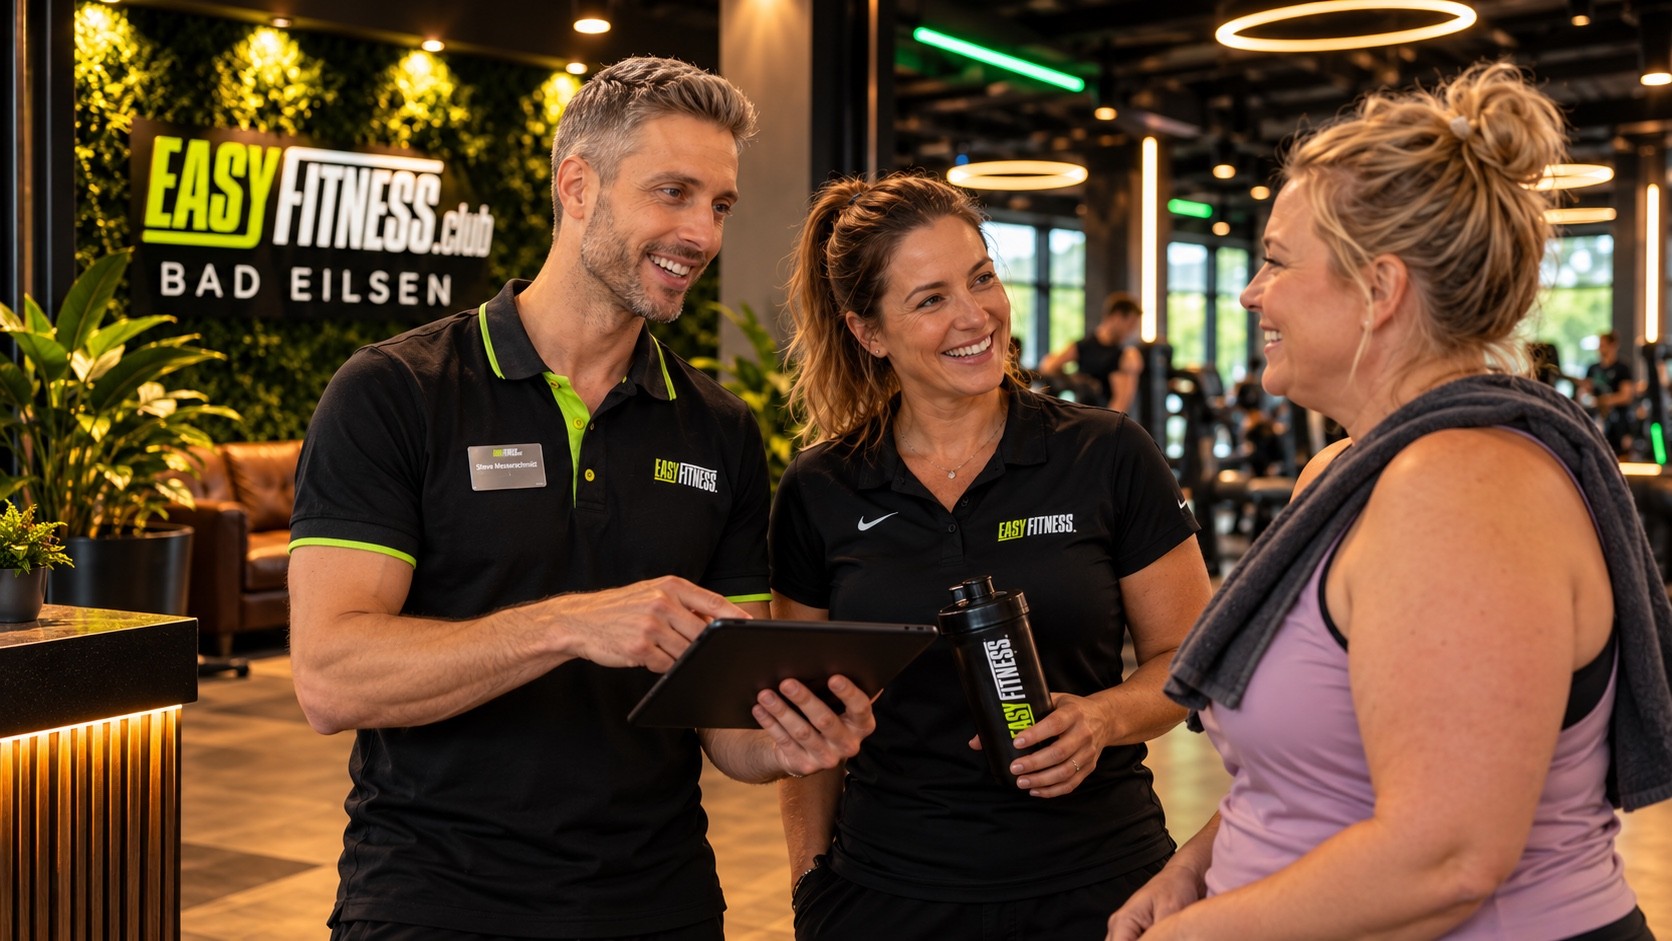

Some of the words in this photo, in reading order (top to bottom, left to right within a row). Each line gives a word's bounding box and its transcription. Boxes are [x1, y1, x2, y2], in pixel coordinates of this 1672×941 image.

[142, 135, 282, 249] EASY
[160, 260, 261, 299] BAD
[290, 266, 451, 307] EILSEN
[654, 457, 680, 484] EASY
[997, 518, 1027, 542] EASY
